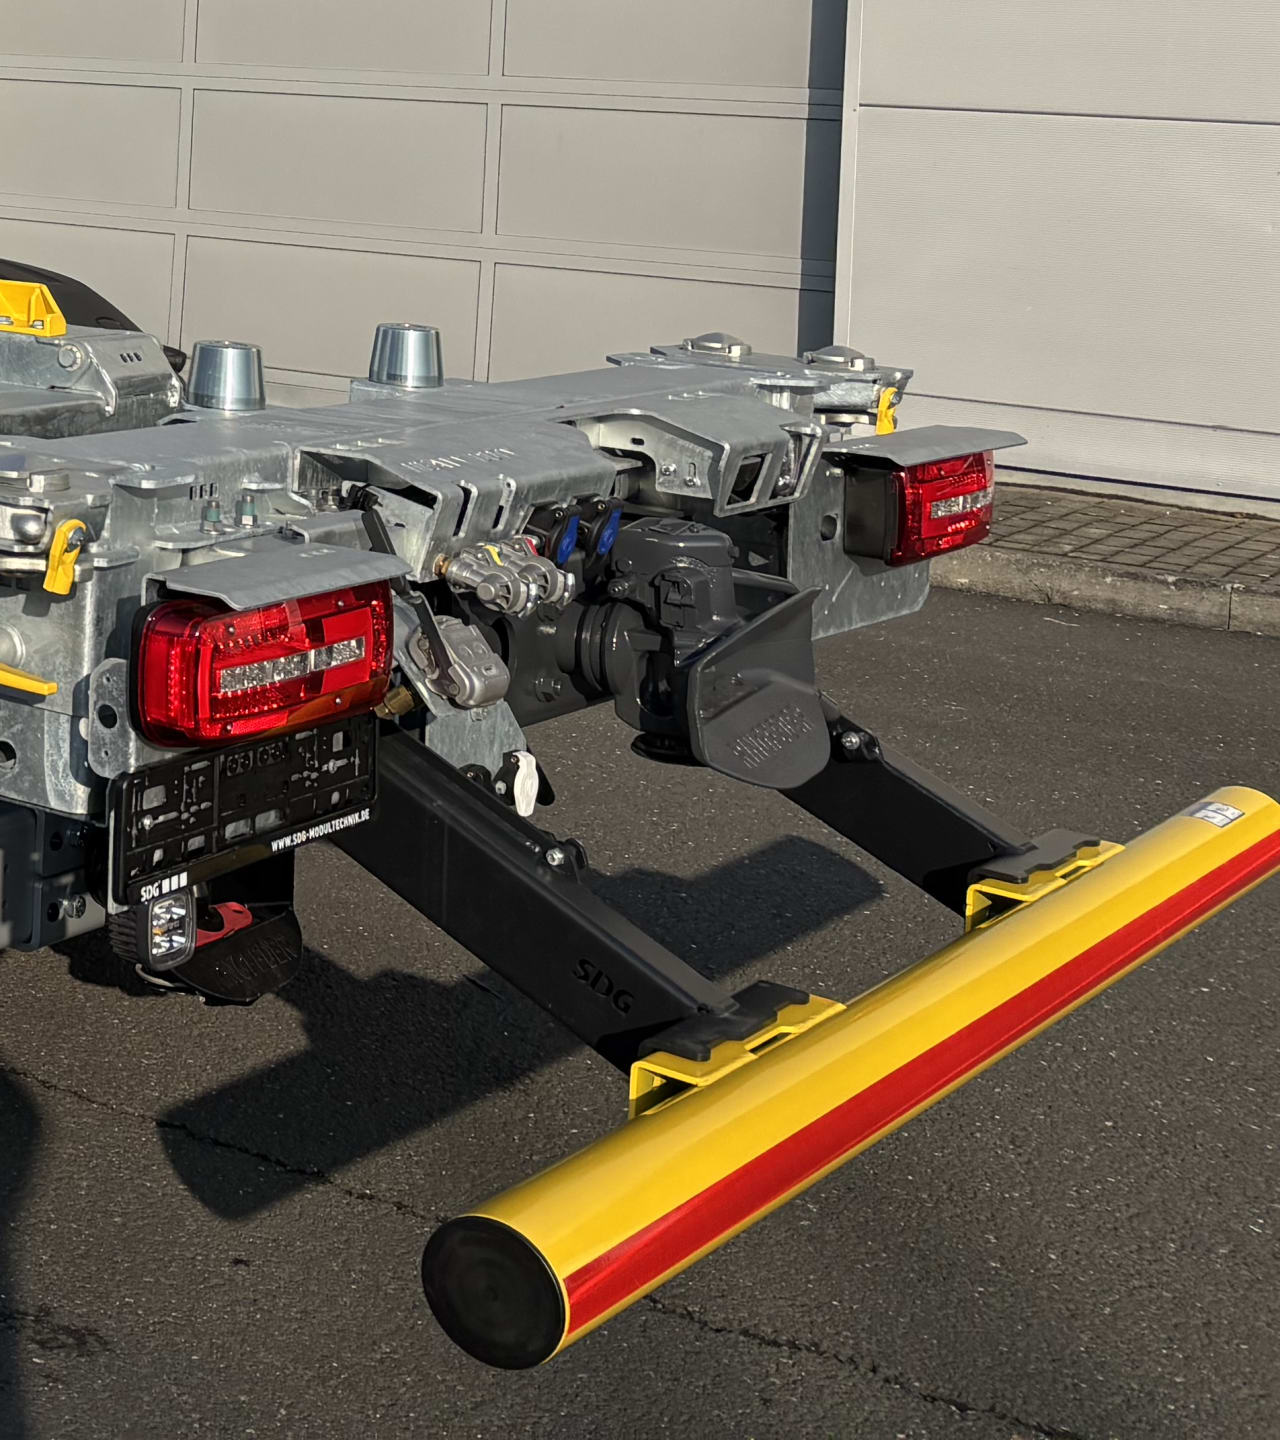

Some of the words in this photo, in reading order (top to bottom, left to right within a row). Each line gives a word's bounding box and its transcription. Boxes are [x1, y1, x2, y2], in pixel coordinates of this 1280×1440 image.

[271, 808, 370, 852] WWW.SDG-MODULTECHNIK.DE
[140, 881, 160, 903] SDG
[572, 958, 635, 1015] SDG
